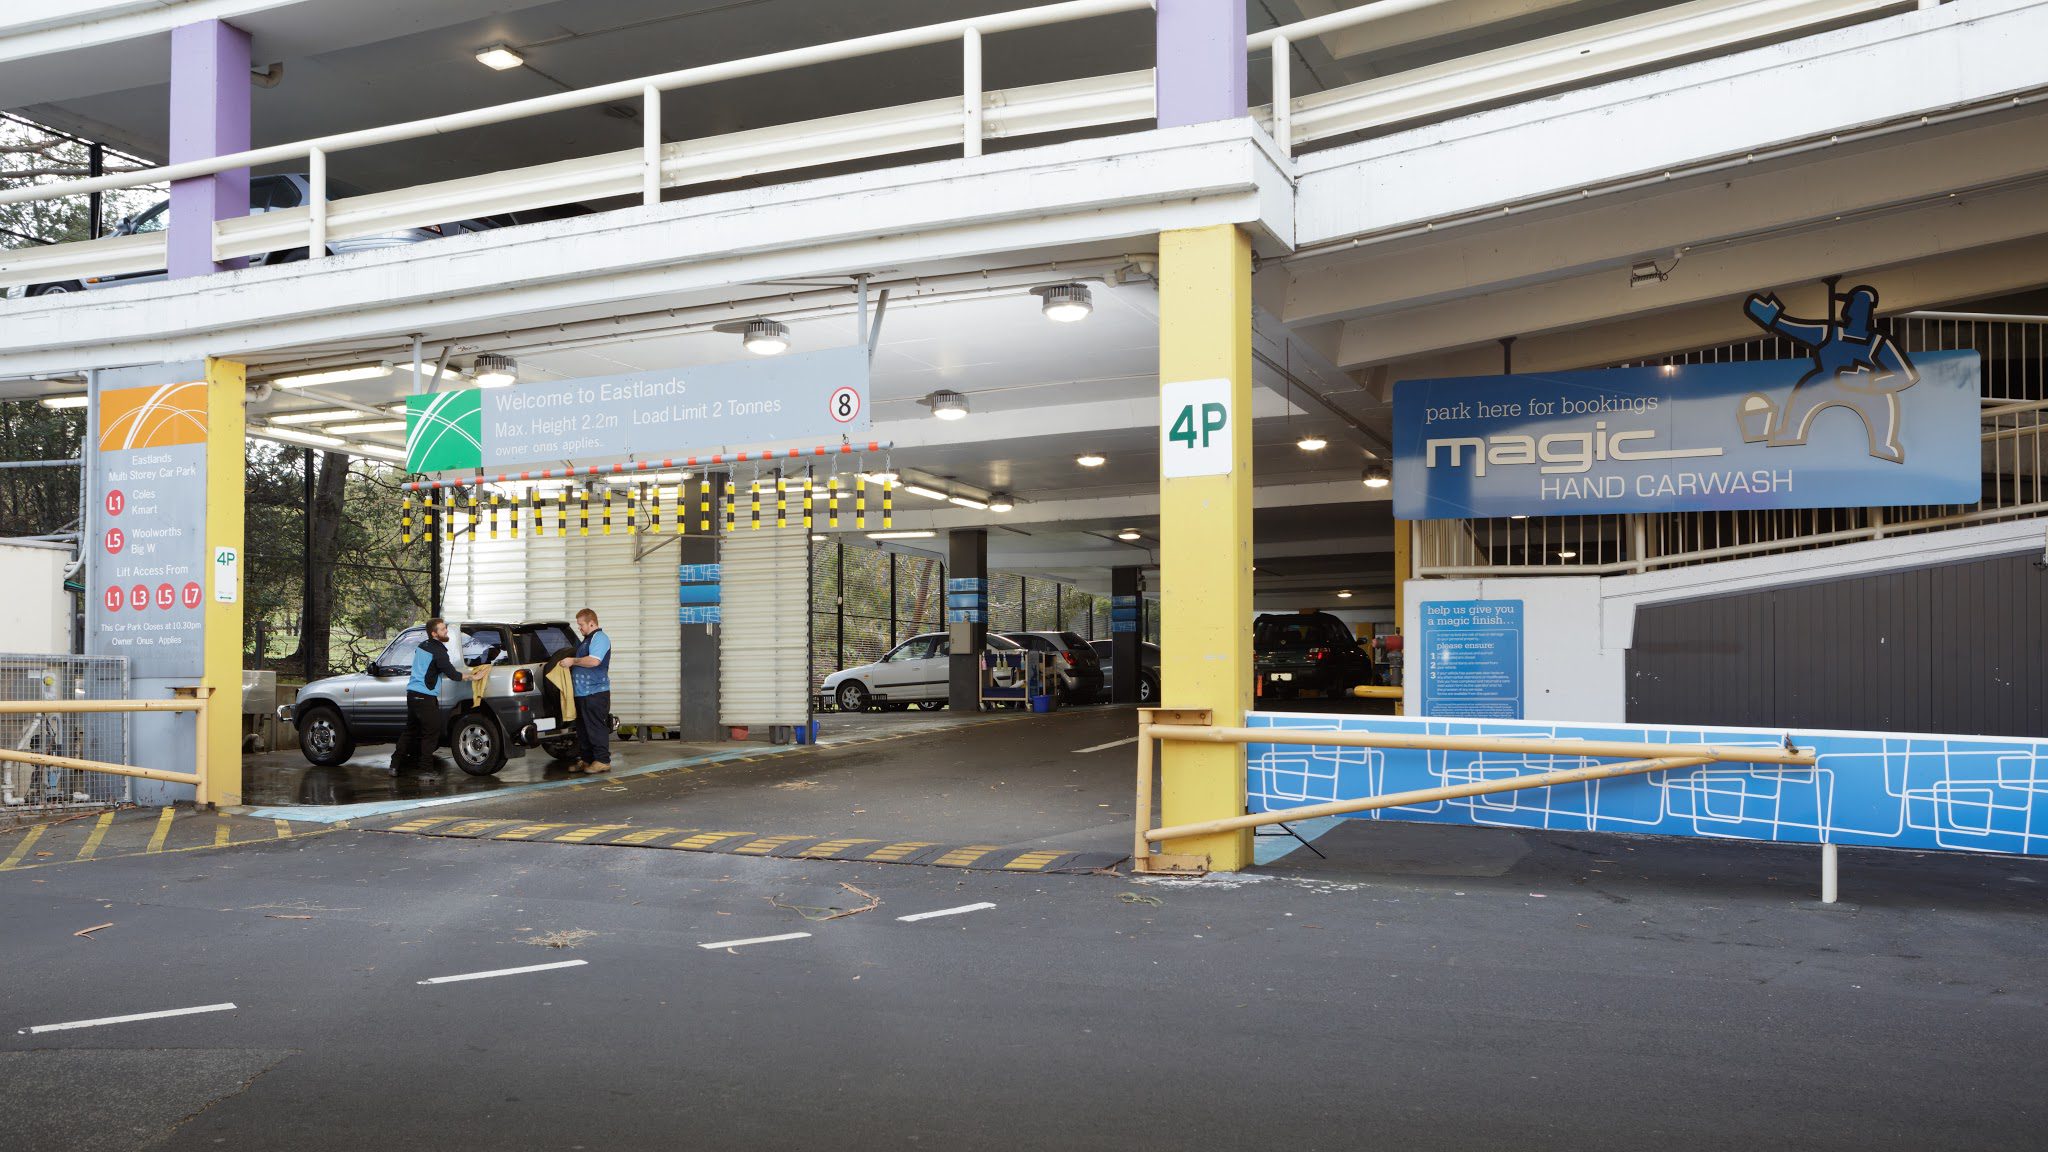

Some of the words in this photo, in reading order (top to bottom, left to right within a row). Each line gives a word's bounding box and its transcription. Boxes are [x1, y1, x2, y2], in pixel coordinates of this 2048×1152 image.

[495, 391, 573, 412] Welcome
[577, 387, 595, 404] to
[600, 377, 686, 401] Eastlands
[838, 393, 851, 417] 8
[1425, 402, 1471, 424] park
[1477, 397, 1522, 420] here
[1527, 396, 1554, 416] for
[1561, 394, 1659, 416] bookings
[495, 422, 528, 437] Max.
[531, 416, 577, 436] Height
[581, 413, 618, 430] 2.2m
[633, 405, 669, 425] Load
[673, 401, 708, 421] Limit
[713, 402, 722, 418] 2
[728, 400, 782, 416] Tonnes
[1169, 402, 1227, 449] 4P
[495, 444, 528, 456] owner
[1426, 421, 1723, 477] magic
[132, 454, 172, 465] Eastlands
[108, 471, 128, 482] Multi
[129, 469, 157, 480] Storey
[159, 467, 174, 478] Car
[176, 465, 196, 477] Park
[1541, 475, 1625, 500] HAND
[1636, 469, 1793, 497] CARWASH
[132, 489, 156, 500] Coles
[109, 495, 121, 511] L1
[131, 504, 158, 515] Kmart
[132, 527, 182, 539] Woolworths
[107, 533, 121, 548] L5
[131, 544, 145, 556] Big
[147, 543, 156, 553] W
[216, 551, 236, 567] 4P
[116, 567, 131, 577] Lift
[133, 566, 164, 577] Access
[165, 564, 189, 575] From
[107, 591, 120, 607] L1
[132, 590, 147, 606] L3
[158, 589, 173, 605] L5
[184, 588, 199, 604] L7
[1427, 605, 1450, 616] help
[1469, 605, 1492, 615] give
[1494, 606, 1514, 615] you
[101, 623, 114, 632] This
[114, 623, 126, 632] Car
[127, 623, 142, 632] Park
[143, 622, 164, 631] Closes
[164, 621, 172, 630] at
[172, 621, 202, 630] 10.30pm
[1437, 617, 1470, 627] magic
[111, 637, 133, 646] Owner
[136, 636, 153, 645] Onus
[158, 636, 182, 645] Applies
[1436, 642, 1463, 651] please
[1431, 652, 1436, 660] 1
[1430, 661, 1436, 669] 2
[1430, 671, 1436, 679] 3
